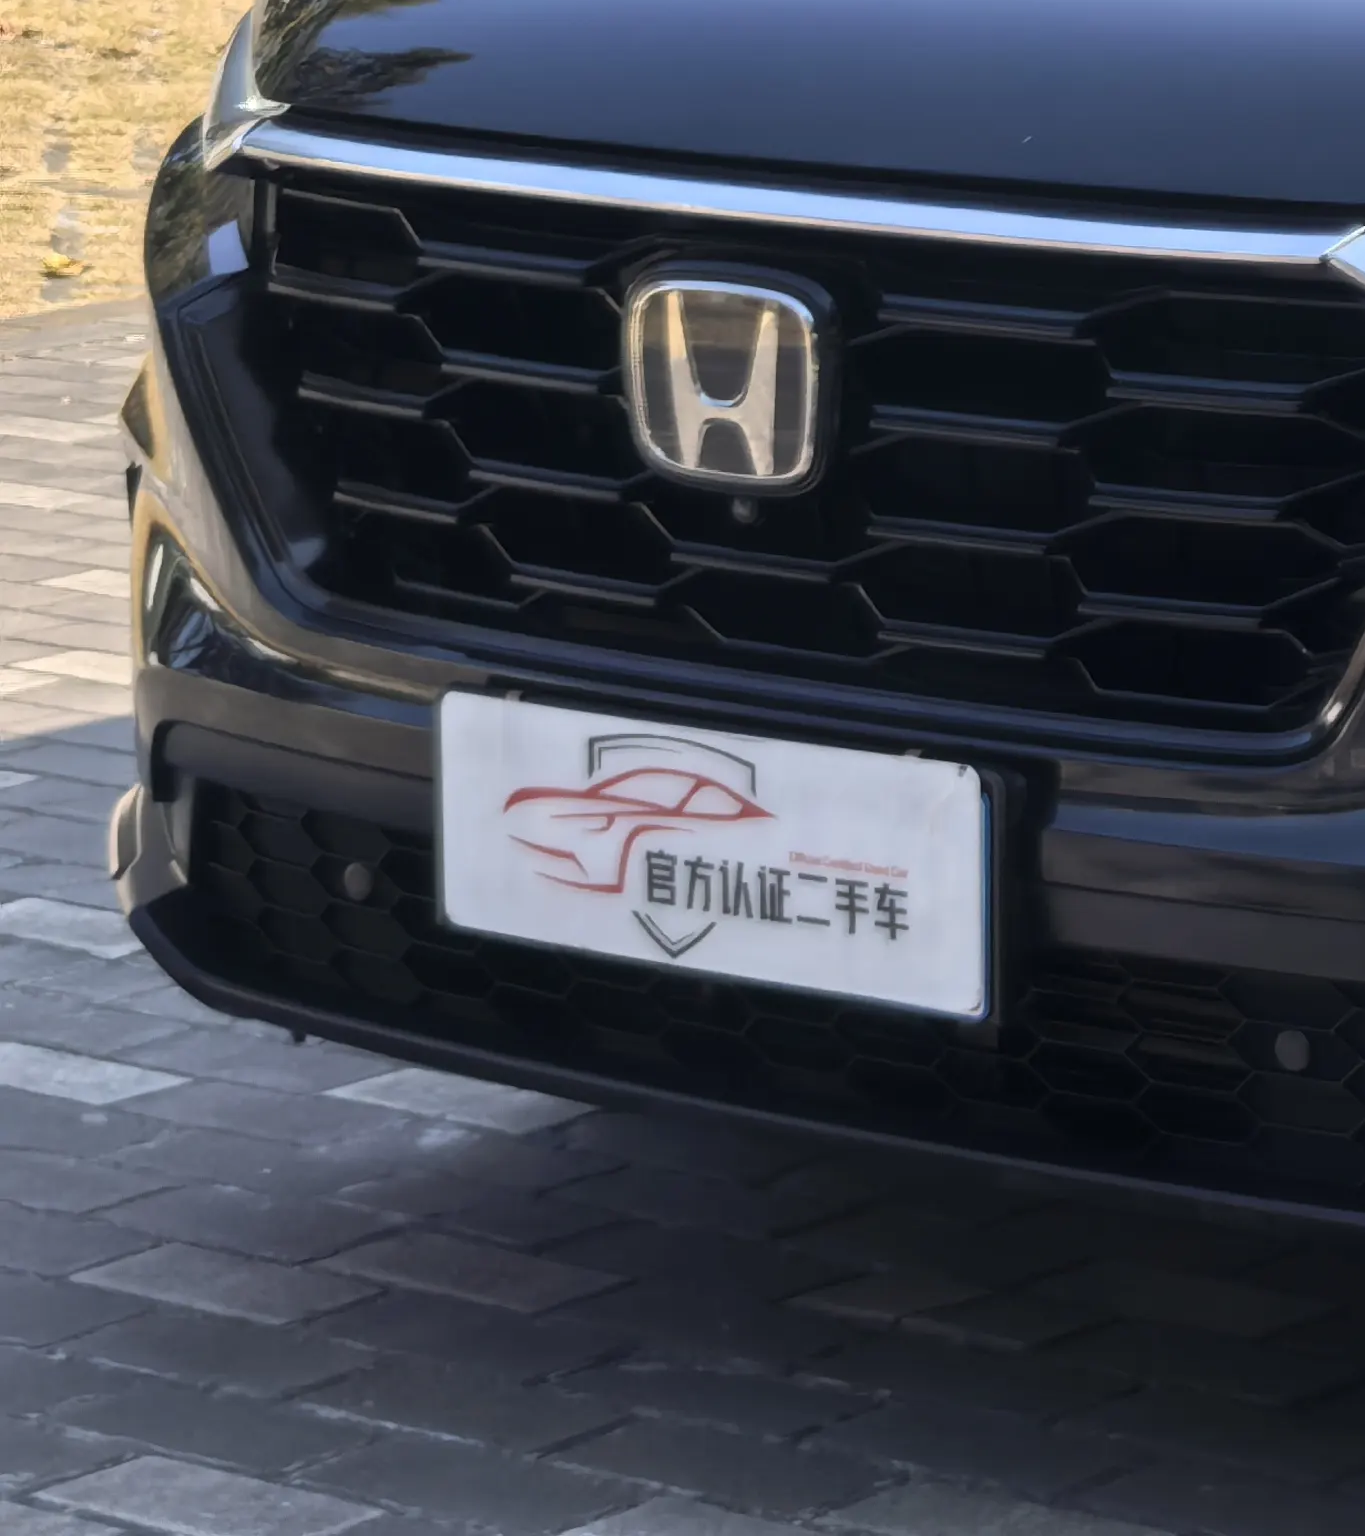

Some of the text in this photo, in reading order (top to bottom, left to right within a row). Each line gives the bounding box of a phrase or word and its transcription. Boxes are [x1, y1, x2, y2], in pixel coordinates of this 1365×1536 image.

[665, 290, 779, 476] H
[645, 849, 910, 941] 官方认证二手车
